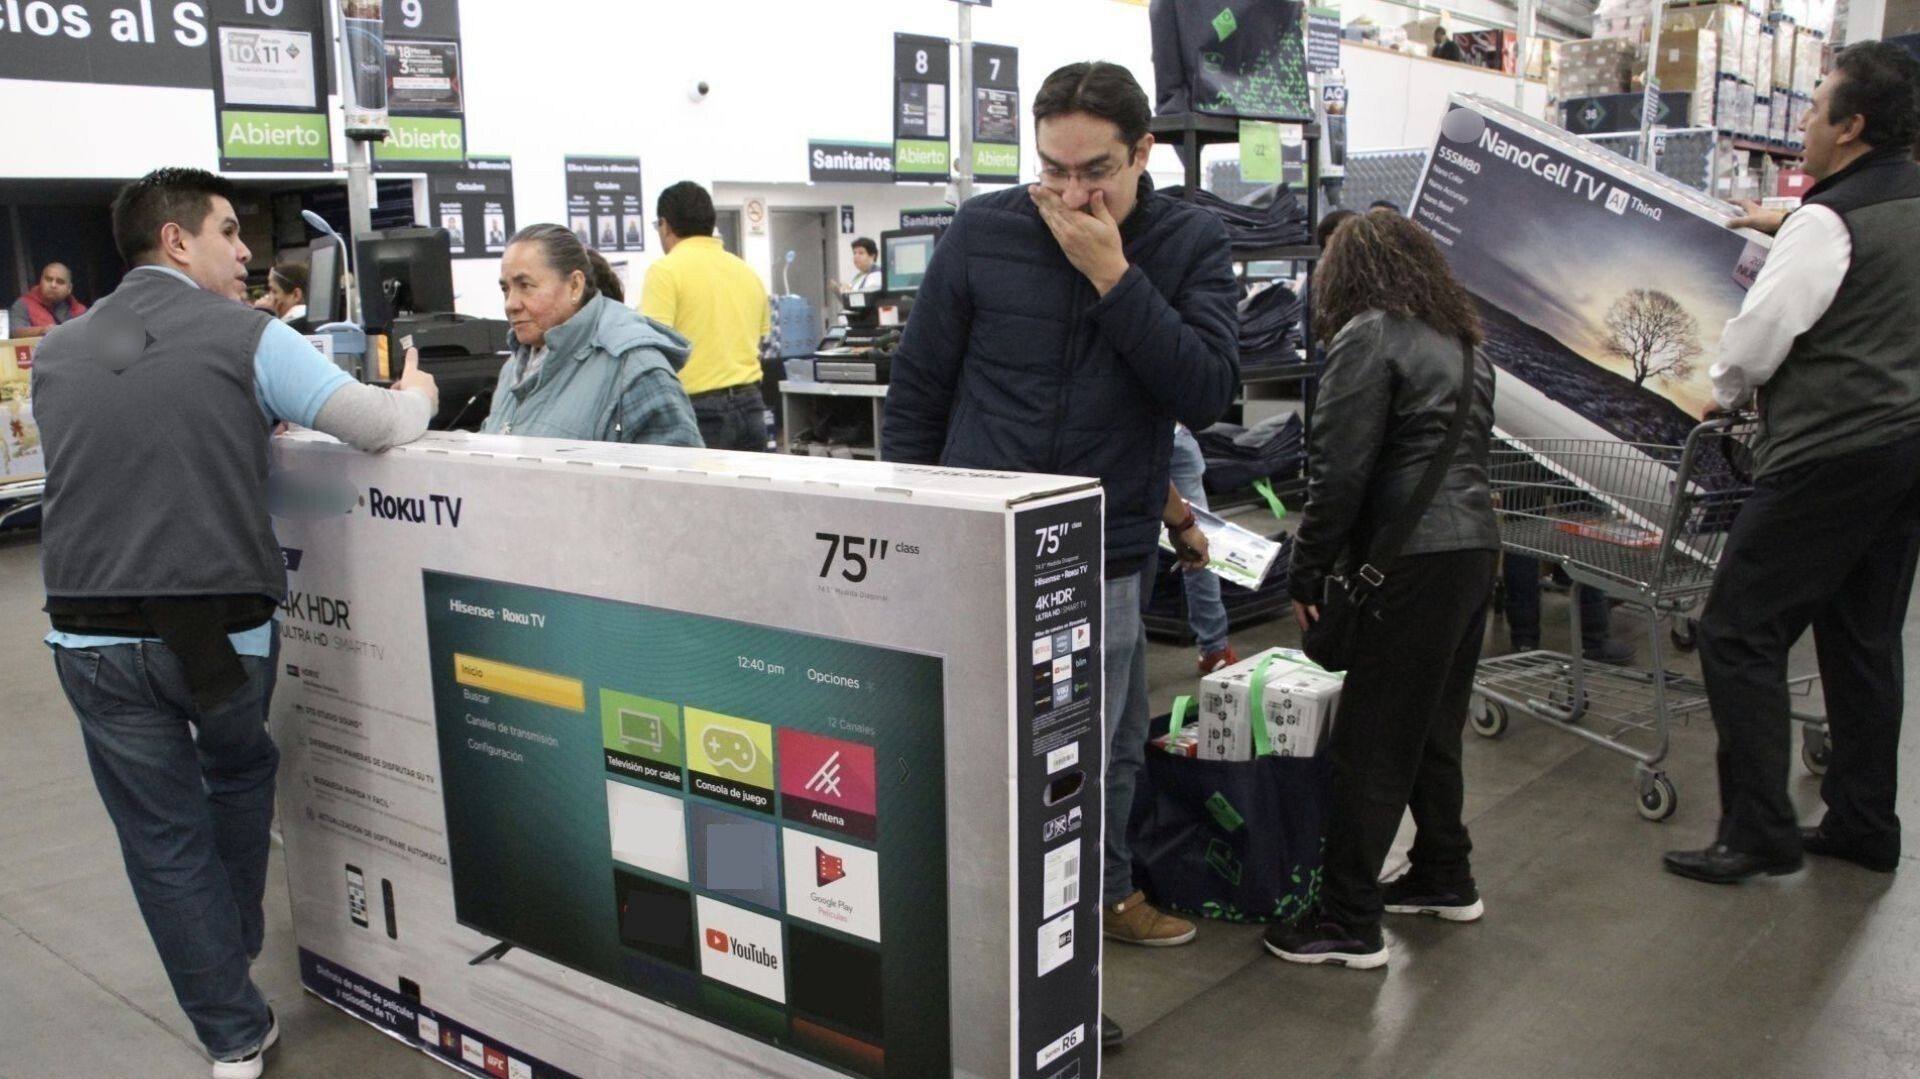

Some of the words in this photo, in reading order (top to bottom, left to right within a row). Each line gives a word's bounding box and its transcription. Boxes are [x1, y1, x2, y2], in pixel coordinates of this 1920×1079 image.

[0, 0, 91, 38] ios
[110, 0, 155, 43] al
[401, 0, 422, 28] 9
[231, 44, 254, 62] 10
[263, 46, 279, 63] 11
[915, 50, 928, 74] 8
[989, 58, 1000, 81] 7
[228, 122, 320, 146] Abierto
[384, 127, 460, 149] Abierto
[813, 149, 892, 171] Sanitarios
[899, 148, 945, 165] Abierto
[977, 151, 1017, 167] Abierto
[594, 181, 620, 190] Octubre
[1479, 128, 1572, 188] NanoCell
[1573, 170, 1606, 201] TV
[1610, 192, 1626, 211] AI
[1631, 196, 1662, 221] ThinQ
[456, 182, 485, 192] Octubre
[903, 213, 954, 228] Sanitarios
[369, 487, 426, 524] Roku
[429, 494, 462, 528] TV
[1035, 522, 1069, 557] 75"
[816, 532, 888, 583] 75"
[895, 542, 920, 554] class
[1034, 574, 1061, 587] Hisense
[1080, 564, 1088, 574] TV
[280, 591, 305, 620] 4K
[306, 593, 351, 630] HDR
[1035, 593, 1049, 610] 4K
[1050, 588, 1072, 607] HDR
[450, 599, 494, 619] Hisense
[502, 608, 529, 625] Roku
[530, 613, 546, 629] TV
[1035, 611, 1052, 622] ULTRA
[1052, 608, 1061, 616] HD
[1080, 600, 1087, 608] TV
[282, 625, 311, 642] ULTRA
[313, 631, 328, 647] HD
[368, 641, 384, 660] TV
[461, 664, 483, 679] Inicio
[737, 655, 765, 672] 12:40
[767, 662, 785, 677] pm
[807, 668, 860, 689] Opciones
[463, 688, 491, 704] Buscar
[465, 713, 497, 731] Canales
[498, 722, 509, 735] de
[510, 723, 559, 747] transmisión
[828, 716, 837, 728] 12
[839, 718, 876, 737] Canales
[467, 738, 524, 763] Configuración
[372, 757, 382, 767] DE
[416, 770, 425, 781] SU
[425, 774, 435, 784] TV
[607, 755, 642, 773] Televisión
[644, 766, 658, 778] por
[659, 769, 681, 783] cable
[696, 778, 728, 796] Consola
[730, 787, 741, 798] de
[742, 790, 767, 806] juego
[811, 808, 845, 826] Antena
[810, 891, 836, 910] Google
[837, 899, 853, 915] Play
[730, 936, 778, 969] YouTube
[316, 964, 342, 984] Disfruta
[342, 978, 352, 990] de
[353, 984, 372, 999] miles
[372, 992, 382, 1004] de
[383, 999, 415, 1020] películas
[341, 991, 374, 1013] episodios
[374, 1007, 384, 1018] de
[385, 1011, 397, 1025] TV.
[1062, 1031, 1077, 1051] R6
